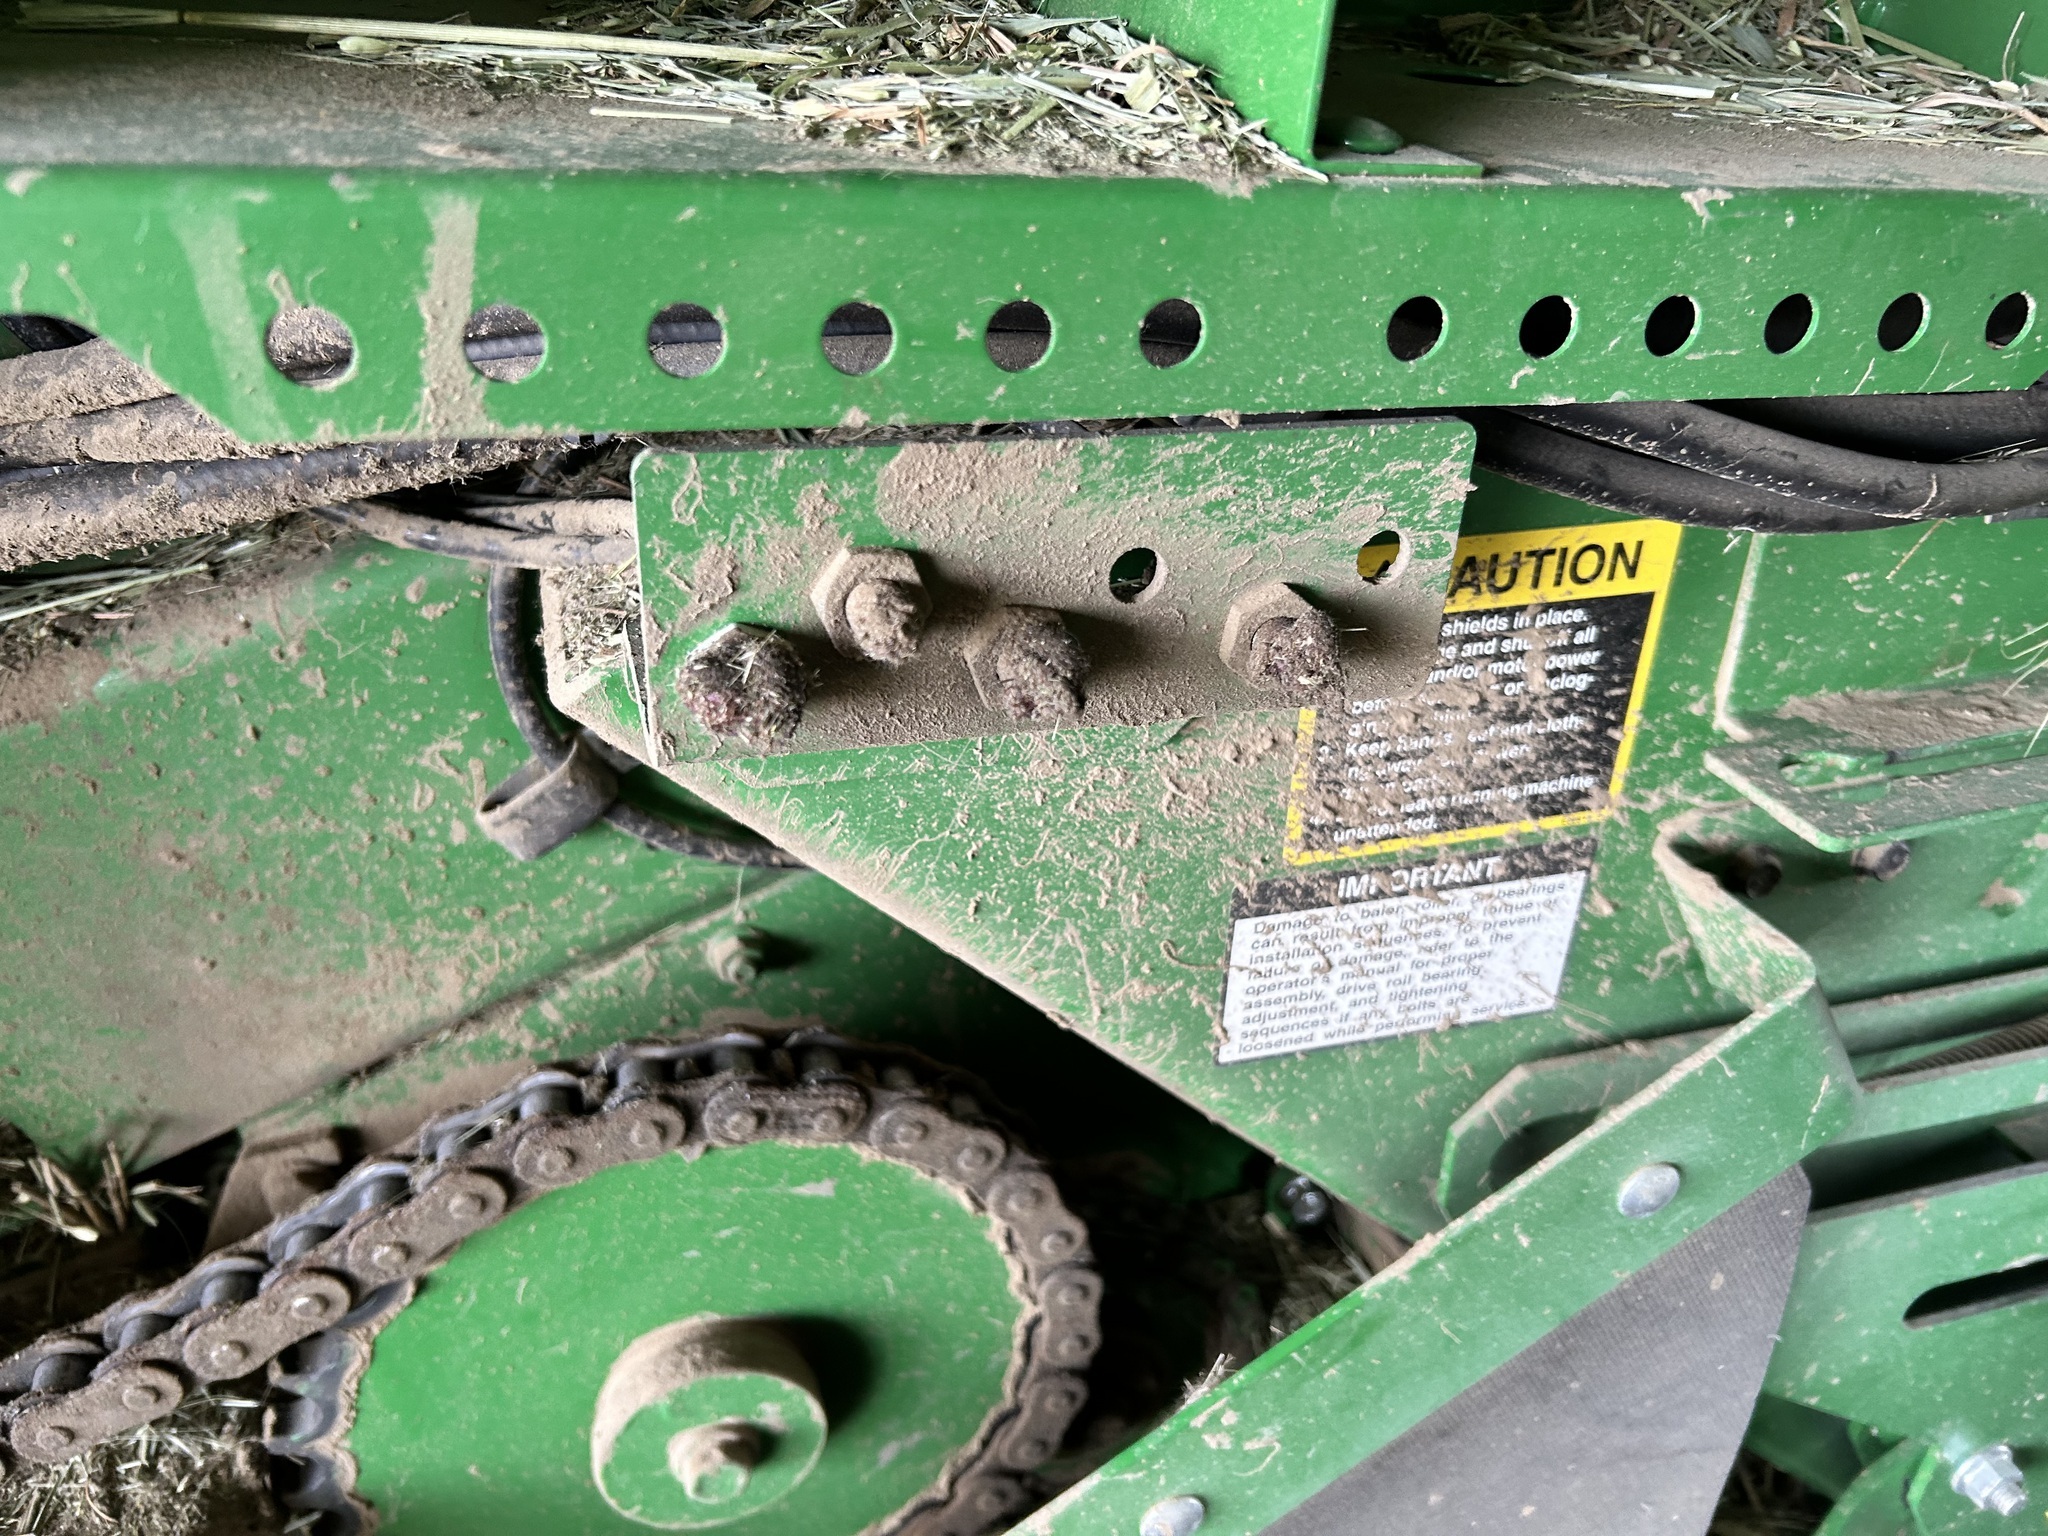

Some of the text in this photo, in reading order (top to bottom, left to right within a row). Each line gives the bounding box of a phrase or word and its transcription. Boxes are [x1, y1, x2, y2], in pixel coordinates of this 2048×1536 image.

[1447, 540, 1644, 599] AUTION
[1441, 608, 1592, 637] shields in place.
[1461, 637, 1497, 658] and
[1573, 625, 1600, 645] all
[1346, 740, 1391, 759] Keep
[1523, 774, 1598, 796] machine
[1497, 882, 1566, 899] bearings
[1482, 913, 1542, 933] prevent
[1251, 934, 1282, 950] can
[1293, 927, 1343, 944] result
[1490, 931, 1514, 945] the
[1411, 958, 1432, 971] for
[1243, 989, 1326, 1011] assembly,
[1336, 981, 1377, 997] drive
[1386, 974, 1413, 989] roll
[1348, 995, 1379, 1009] and
[1388, 980, 1469, 1003] tightening
[1240, 1016, 1330, 1041] sequences
[1238, 1032, 1315, 1054] loosened
